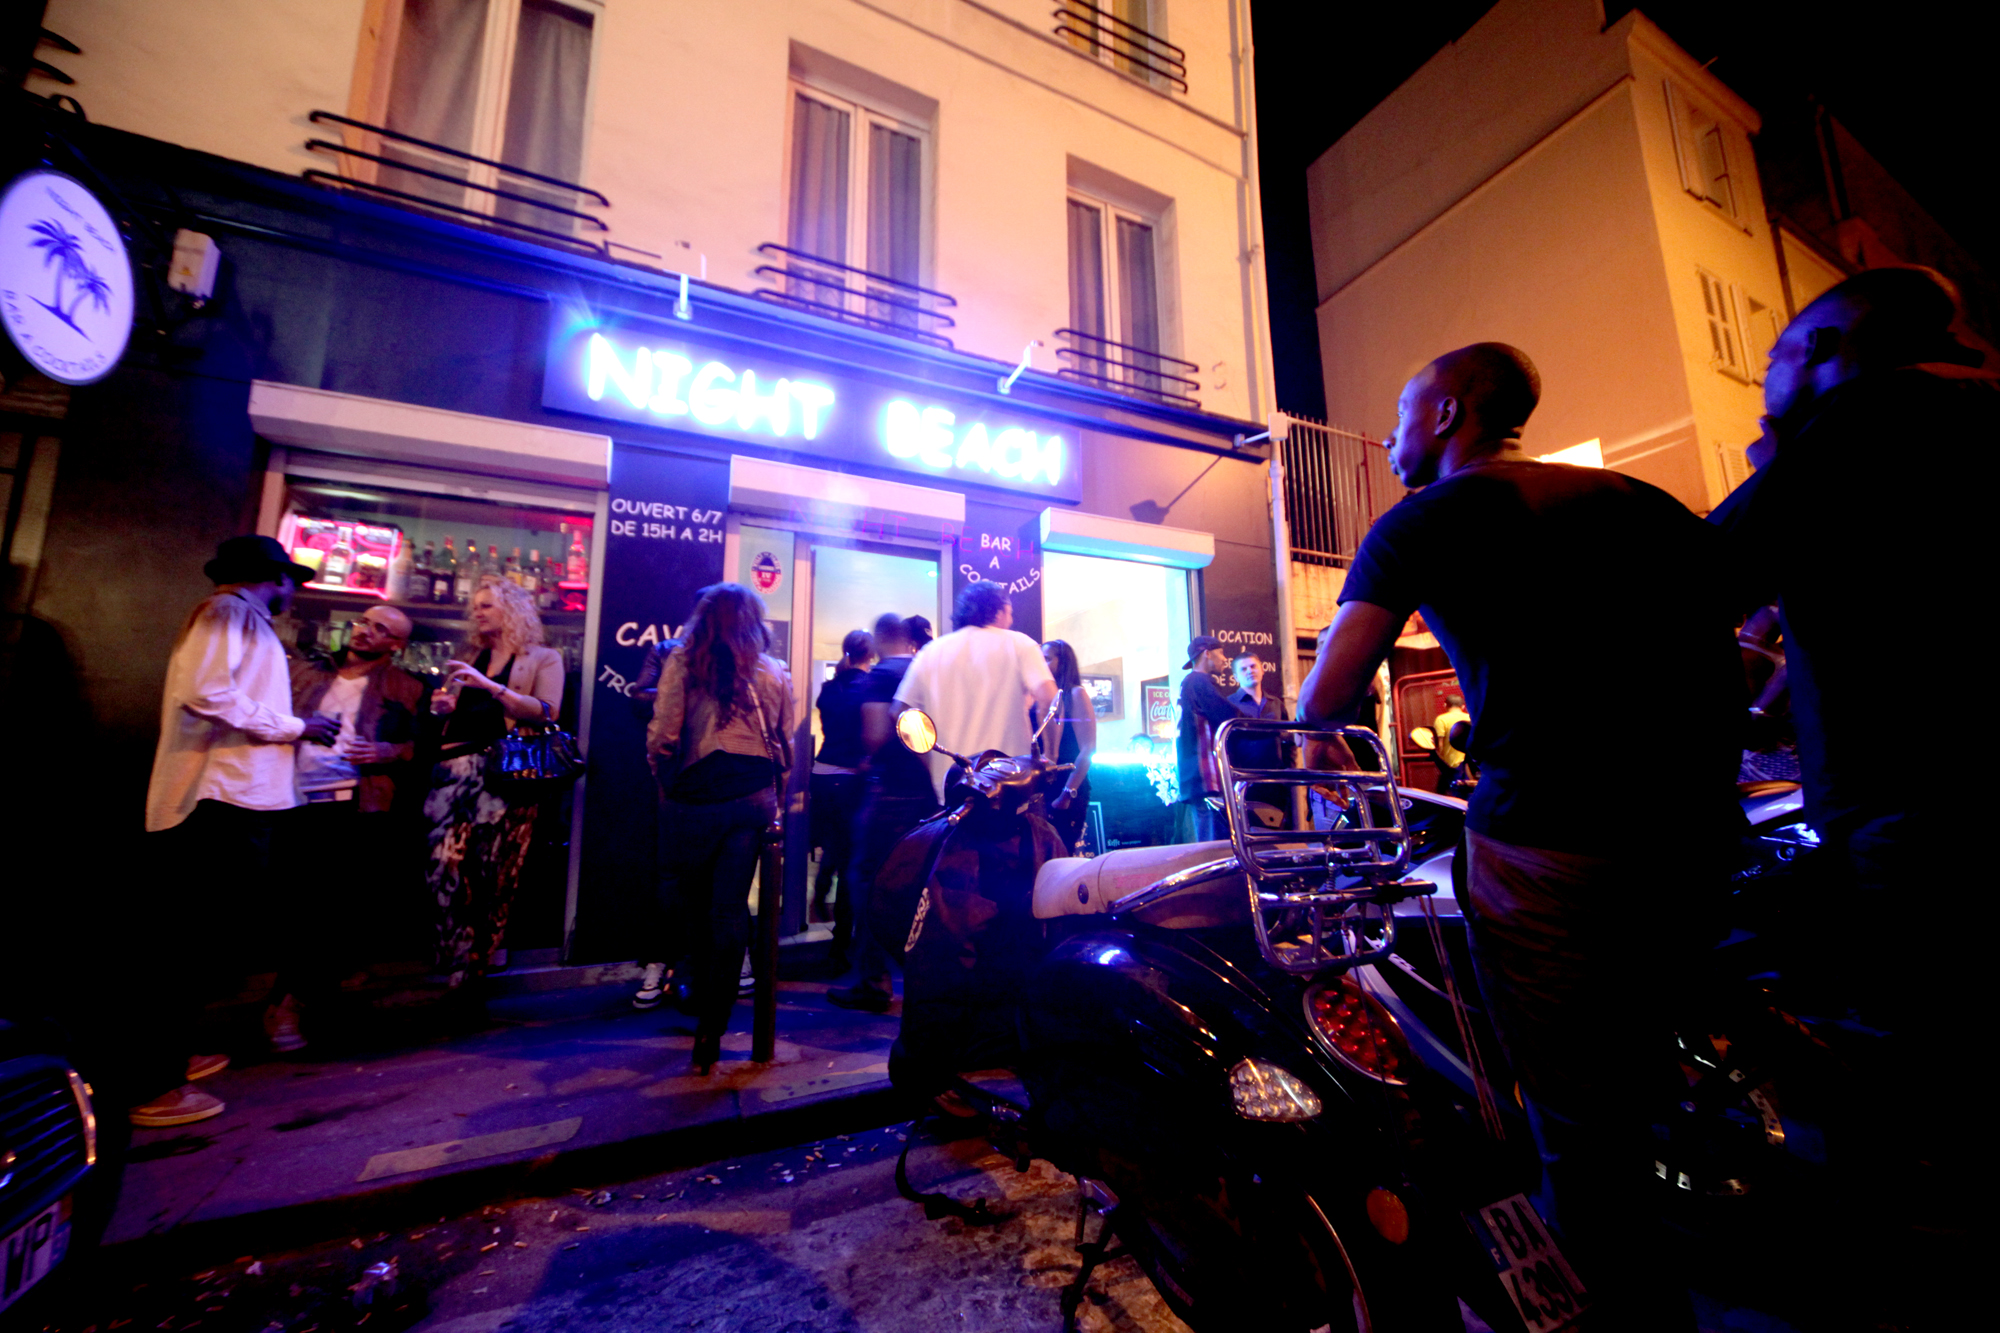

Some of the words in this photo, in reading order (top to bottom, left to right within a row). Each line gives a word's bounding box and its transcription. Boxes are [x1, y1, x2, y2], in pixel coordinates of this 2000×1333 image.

[586, 331, 836, 441] NIGHT
[885, 399, 1065, 487] BEACH
[611, 498, 688, 520] OUVERT
[691, 505, 723, 525] 6/7
[611, 519, 637, 537] DE
[641, 522, 676, 540] 15H
[680, 528, 694, 541] A
[698, 528, 723, 544] 2H
[981, 533, 1011, 552] BAR
[989, 556, 1000, 569] A
[959, 564, 1041, 595] COTAILS
[615, 621, 684, 647] CAV
[1489, 1200, 1547, 1260] BA
